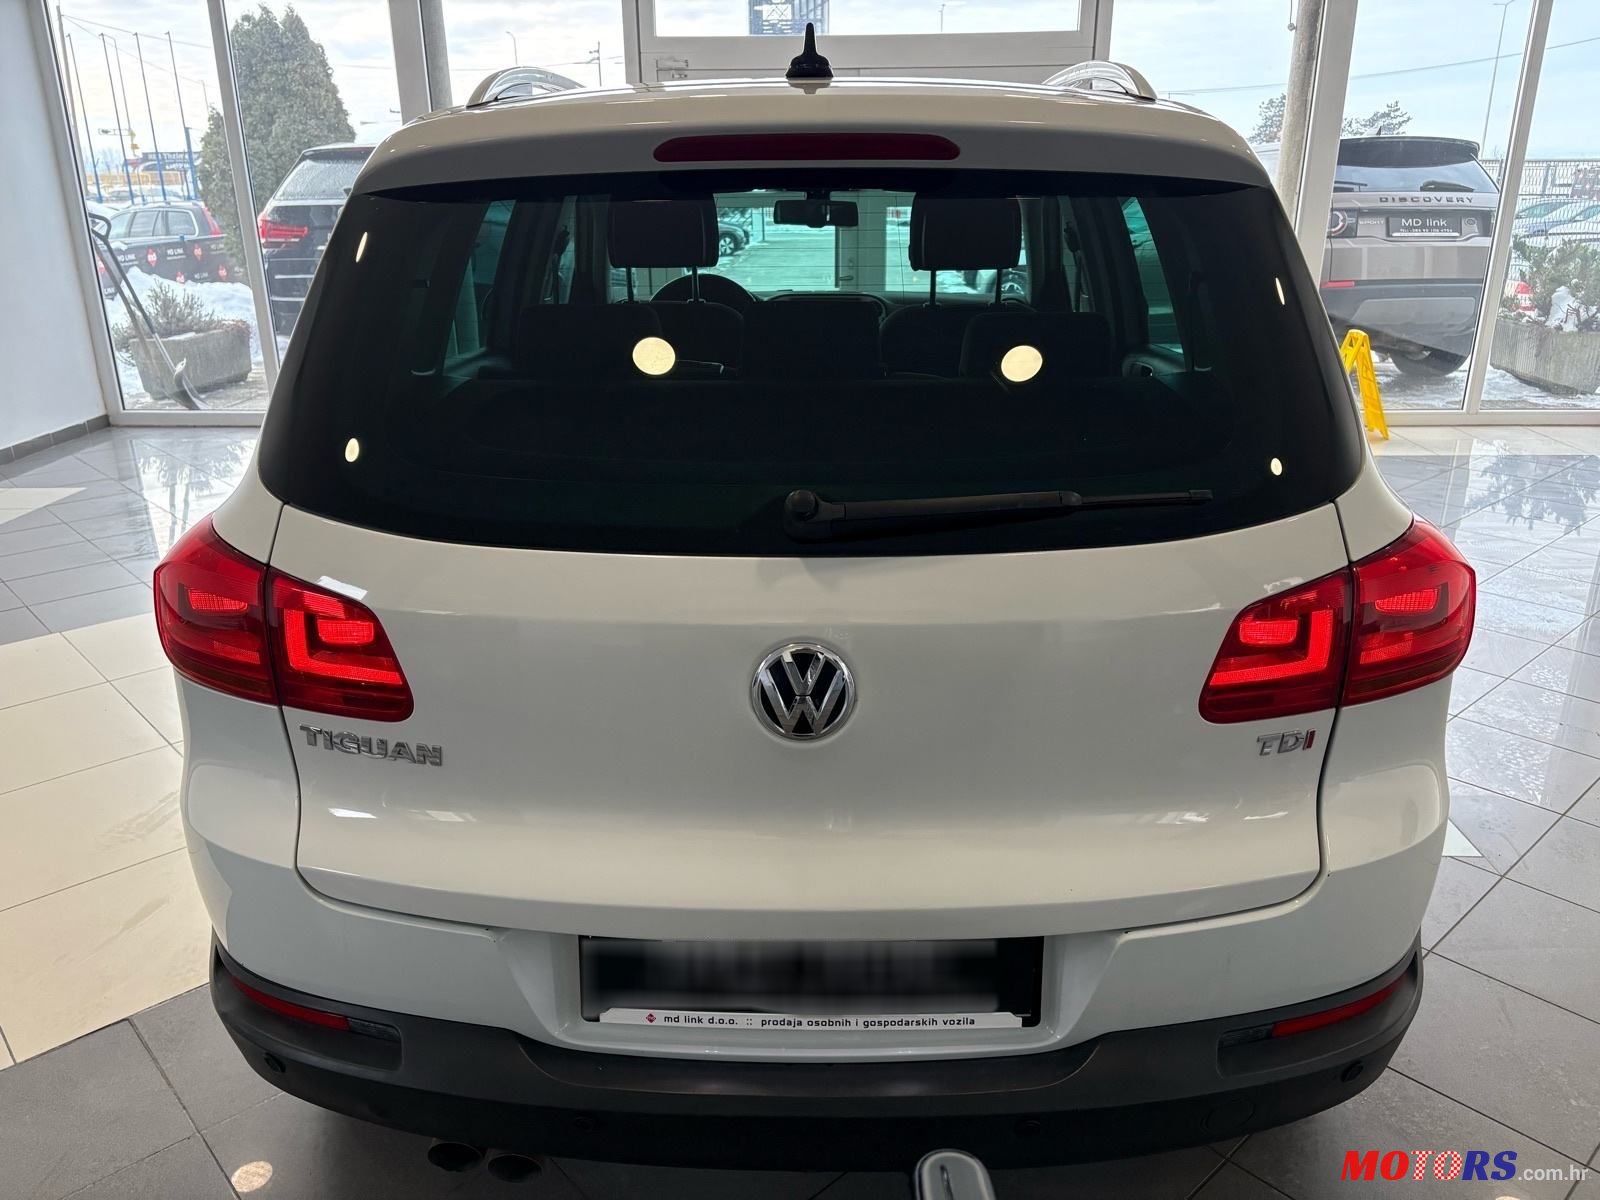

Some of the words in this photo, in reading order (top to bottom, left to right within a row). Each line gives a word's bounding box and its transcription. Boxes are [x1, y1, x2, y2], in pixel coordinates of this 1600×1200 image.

[1379, 196, 1473, 204] DISCOVERY
[1401, 218, 1422, 227] MD
[1426, 218, 1447, 227] link
[299, 724, 443, 767] TIGUAN
[1256, 729, 1317, 757] TDI
[663, 1014, 680, 1024] md
[684, 1015, 704, 1025] link
[708, 1016, 738, 1026] d.o.o.
[761, 1017, 803, 1028] prodaja
[807, 1018, 851, 1028] osobnih
[863, 1017, 938, 1029] gospodarskih
[943, 1017, 975, 1026] vozila
